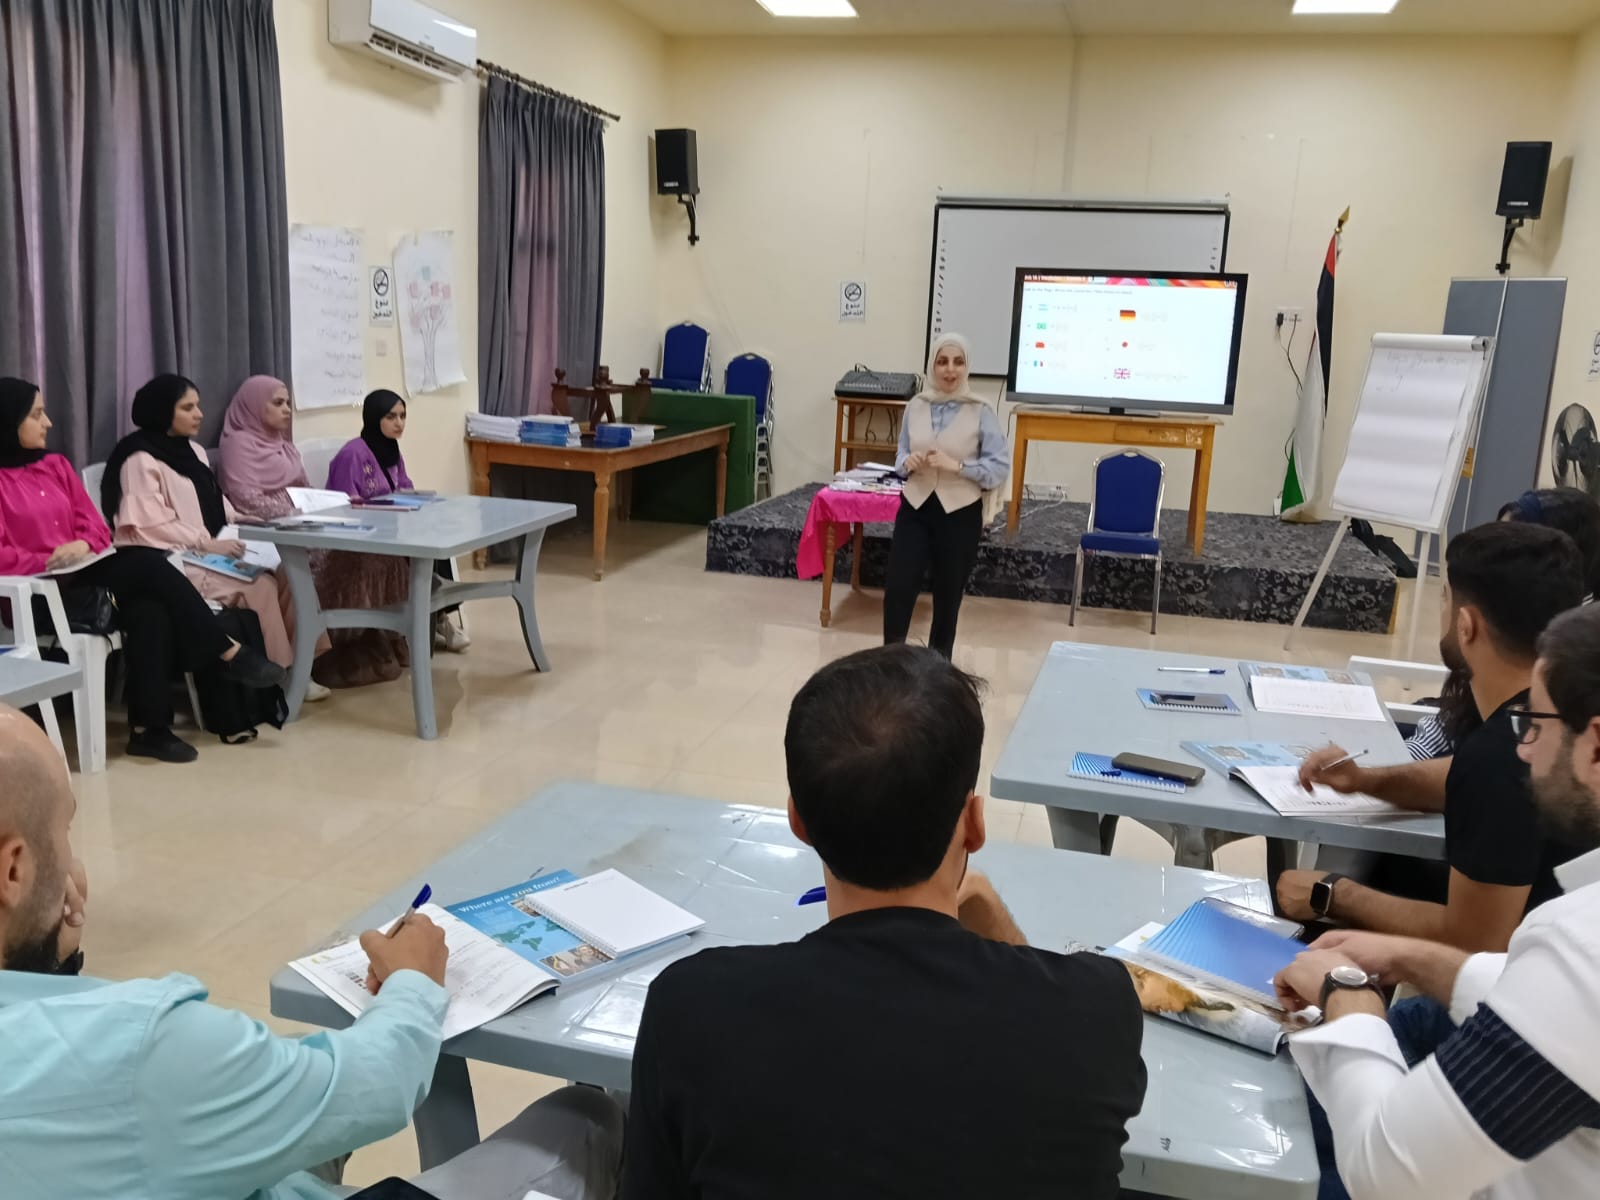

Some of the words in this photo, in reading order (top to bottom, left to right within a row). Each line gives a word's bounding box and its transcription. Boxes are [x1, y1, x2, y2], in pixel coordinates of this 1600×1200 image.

[458, 899, 494, 913] Where
[494, 895, 510, 904] are
[511, 887, 533, 899] you
